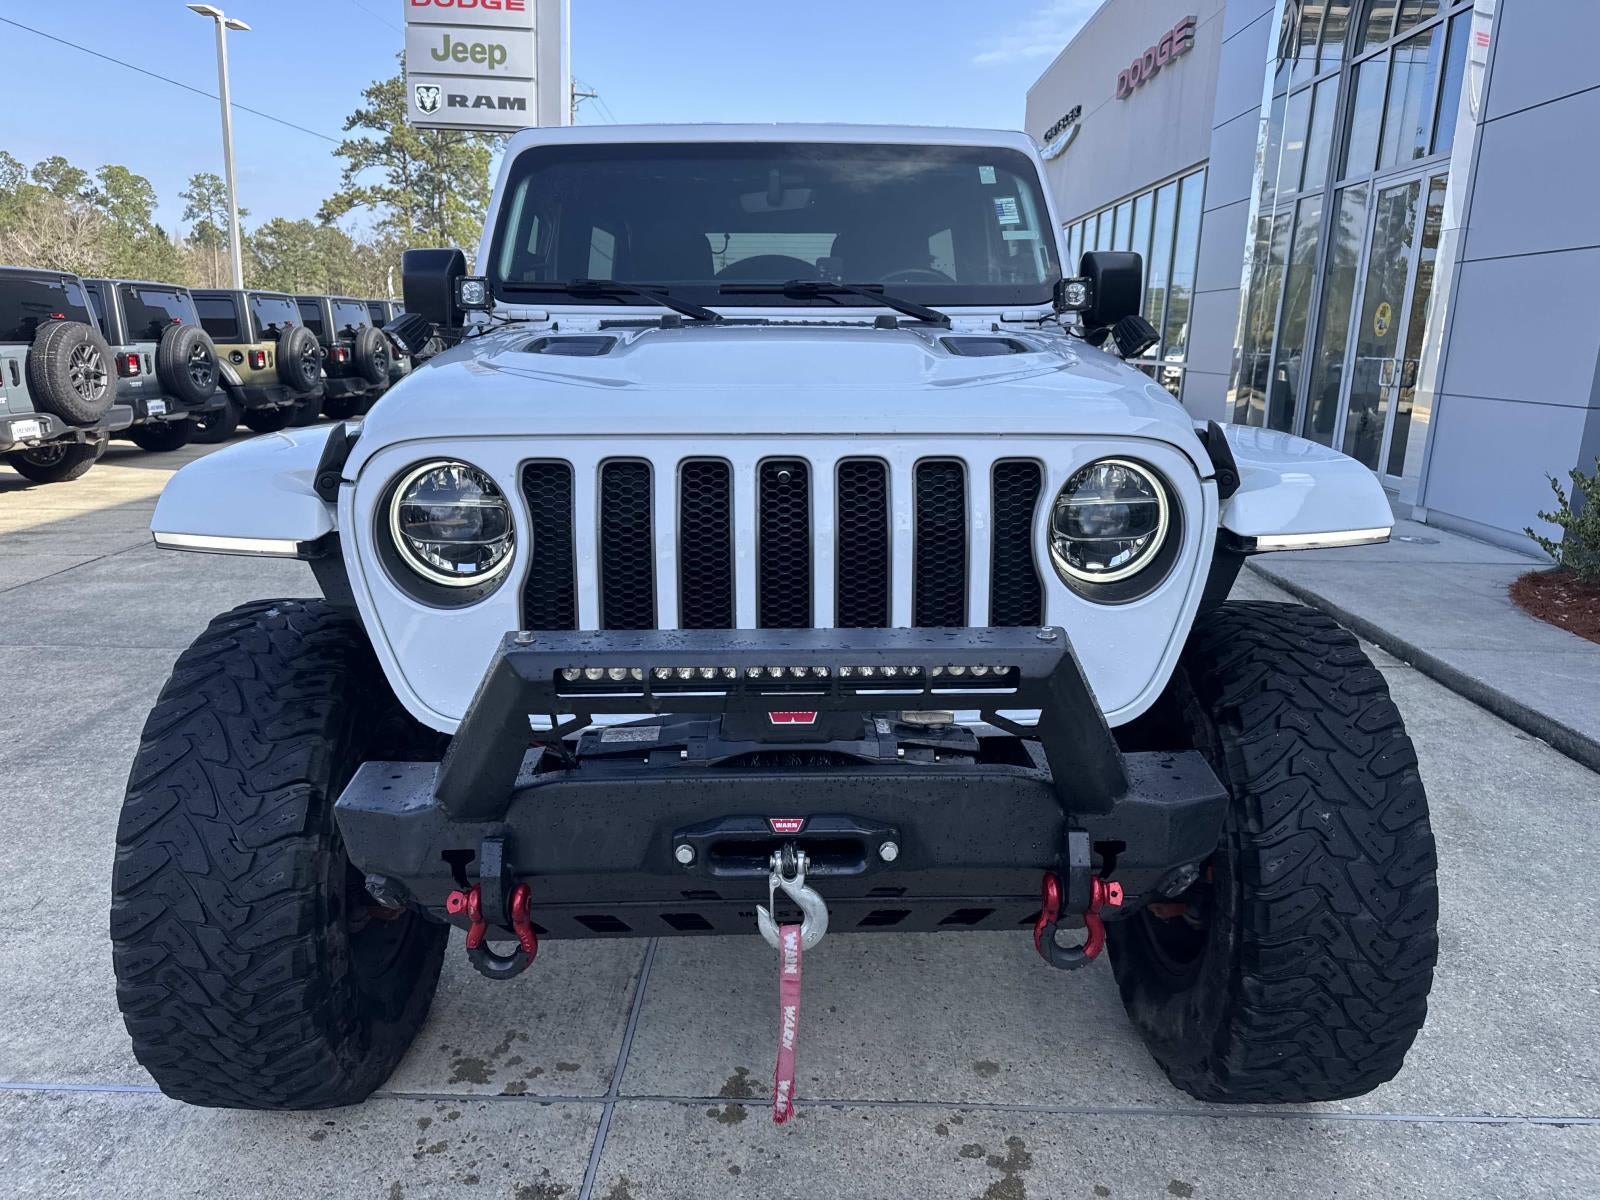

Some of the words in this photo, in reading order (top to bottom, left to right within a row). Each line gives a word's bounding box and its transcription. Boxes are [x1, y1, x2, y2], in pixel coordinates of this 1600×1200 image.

[411, 0, 526, 11] DODGE
[431, 34, 507, 70] Jeep
[1116, 16, 1198, 100] DODGE
[447, 94, 527, 111] RAM
[783, 931, 798, 974] WARN
[782, 1005, 796, 1050] WARN
